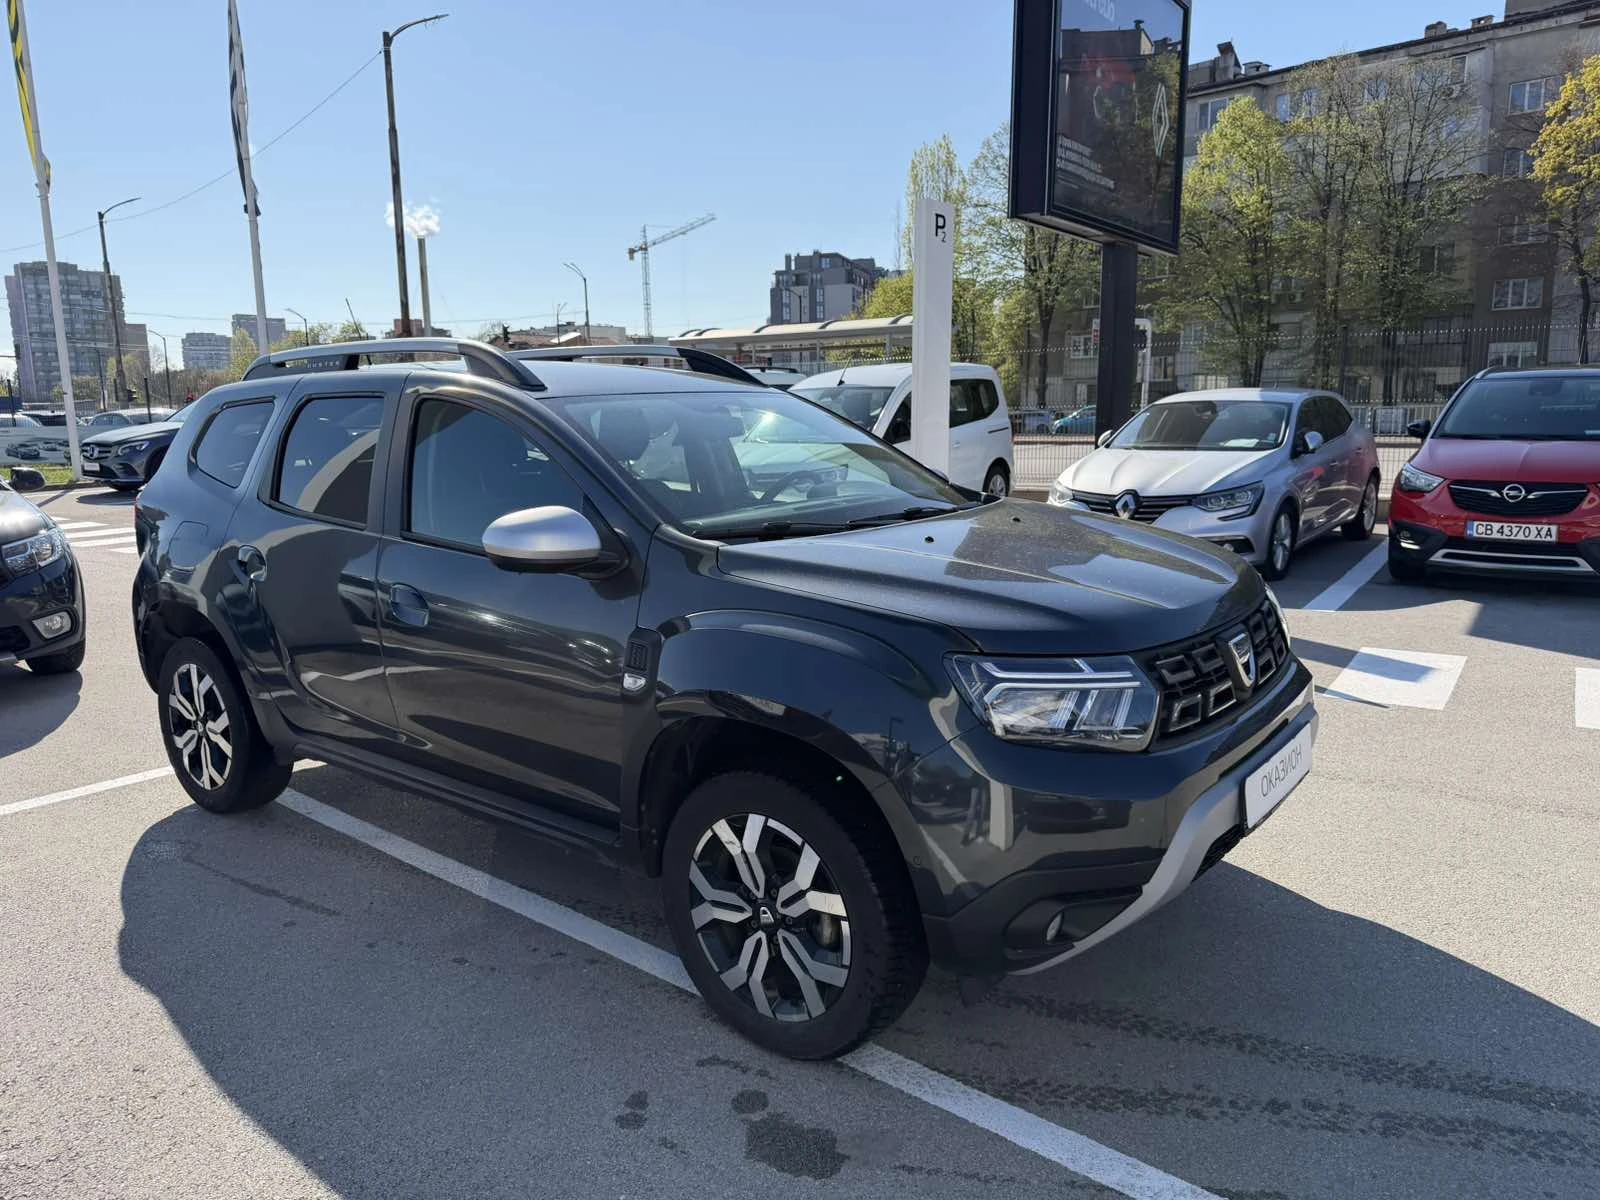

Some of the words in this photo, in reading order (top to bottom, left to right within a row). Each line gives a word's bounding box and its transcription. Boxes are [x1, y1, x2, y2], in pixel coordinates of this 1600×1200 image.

[1476, 524, 1494, 536] CB
[1497, 525, 1531, 538] 4370
[1535, 526, 1553, 539] XA
[1261, 744, 1302, 797] ОКАЗИОН
